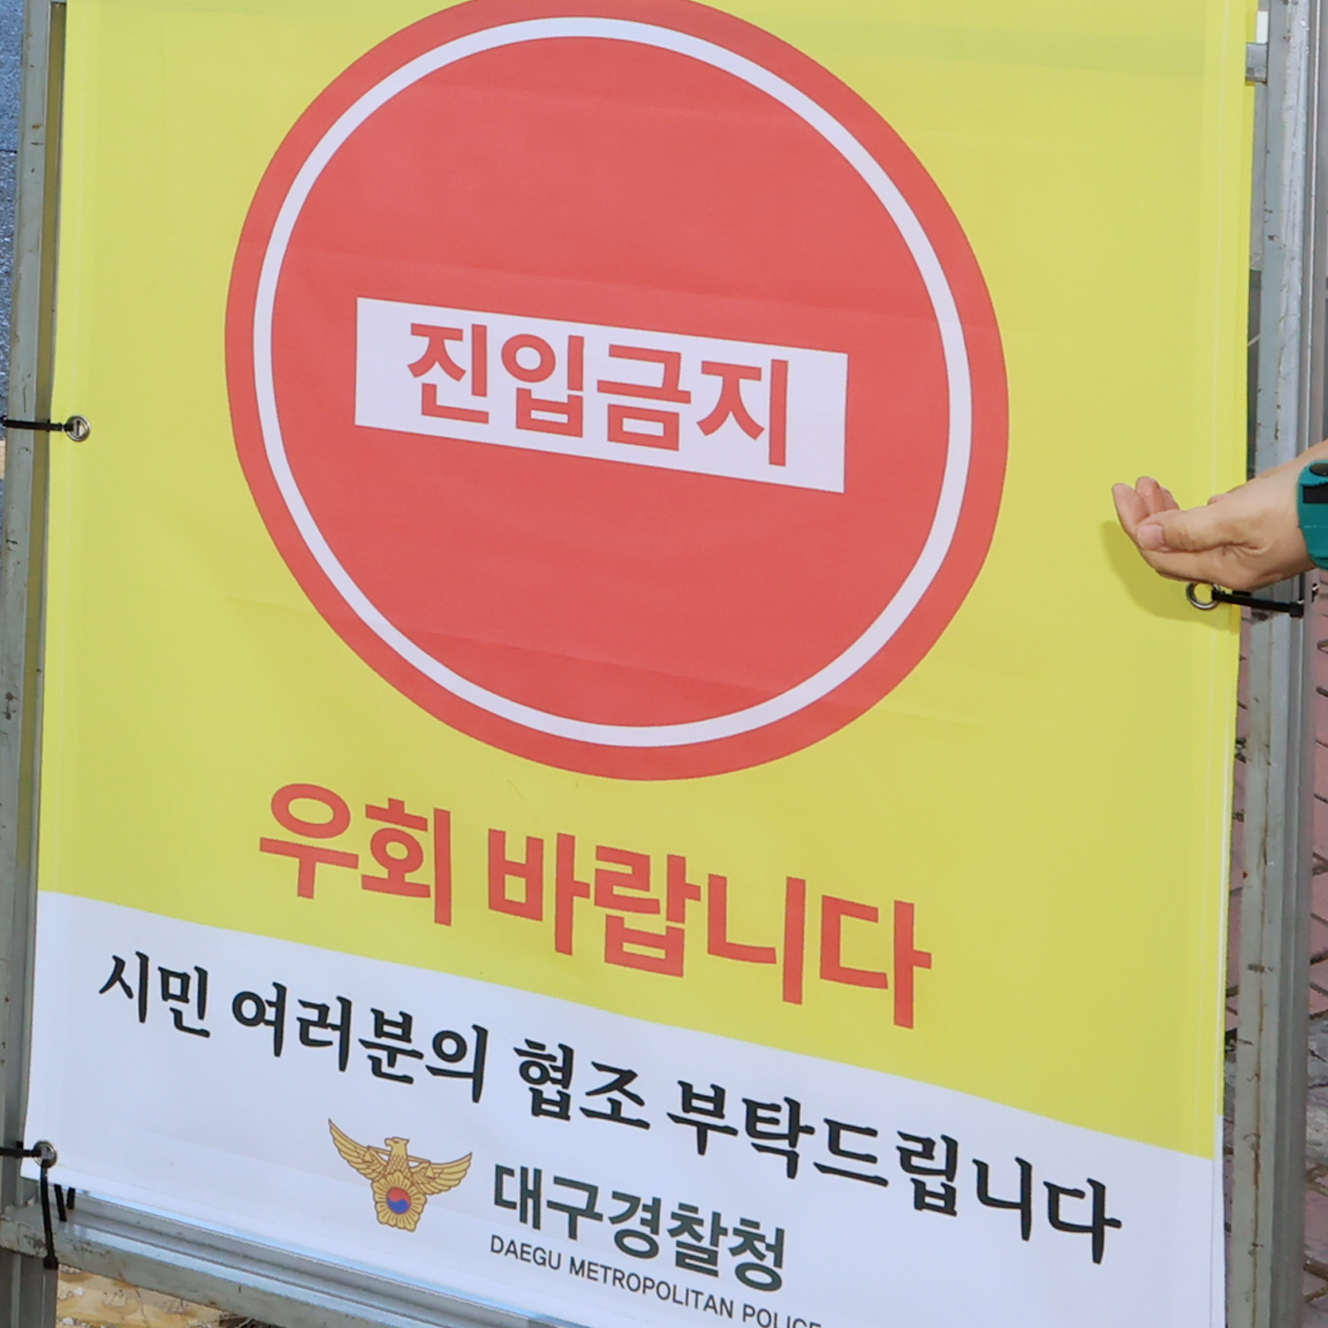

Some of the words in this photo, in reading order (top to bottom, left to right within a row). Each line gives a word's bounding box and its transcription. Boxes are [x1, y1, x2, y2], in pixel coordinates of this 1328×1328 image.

[408, 321, 790, 467] 진입금지
[259, 782, 452, 926] 우회
[487, 827, 932, 1030] 바랍니다
[98, 950, 211, 1038] 시민
[231, 981, 489, 1103] 여러분의
[514, 1037, 652, 1131] 협조
[667, 1080, 1122, 1267] 부탁드립니다
[490, 1234, 562, 1271] DAEGU
[568, 1258, 734, 1320] METROPOLITAN
[494, 1163, 786, 1292] 대구경찰청
